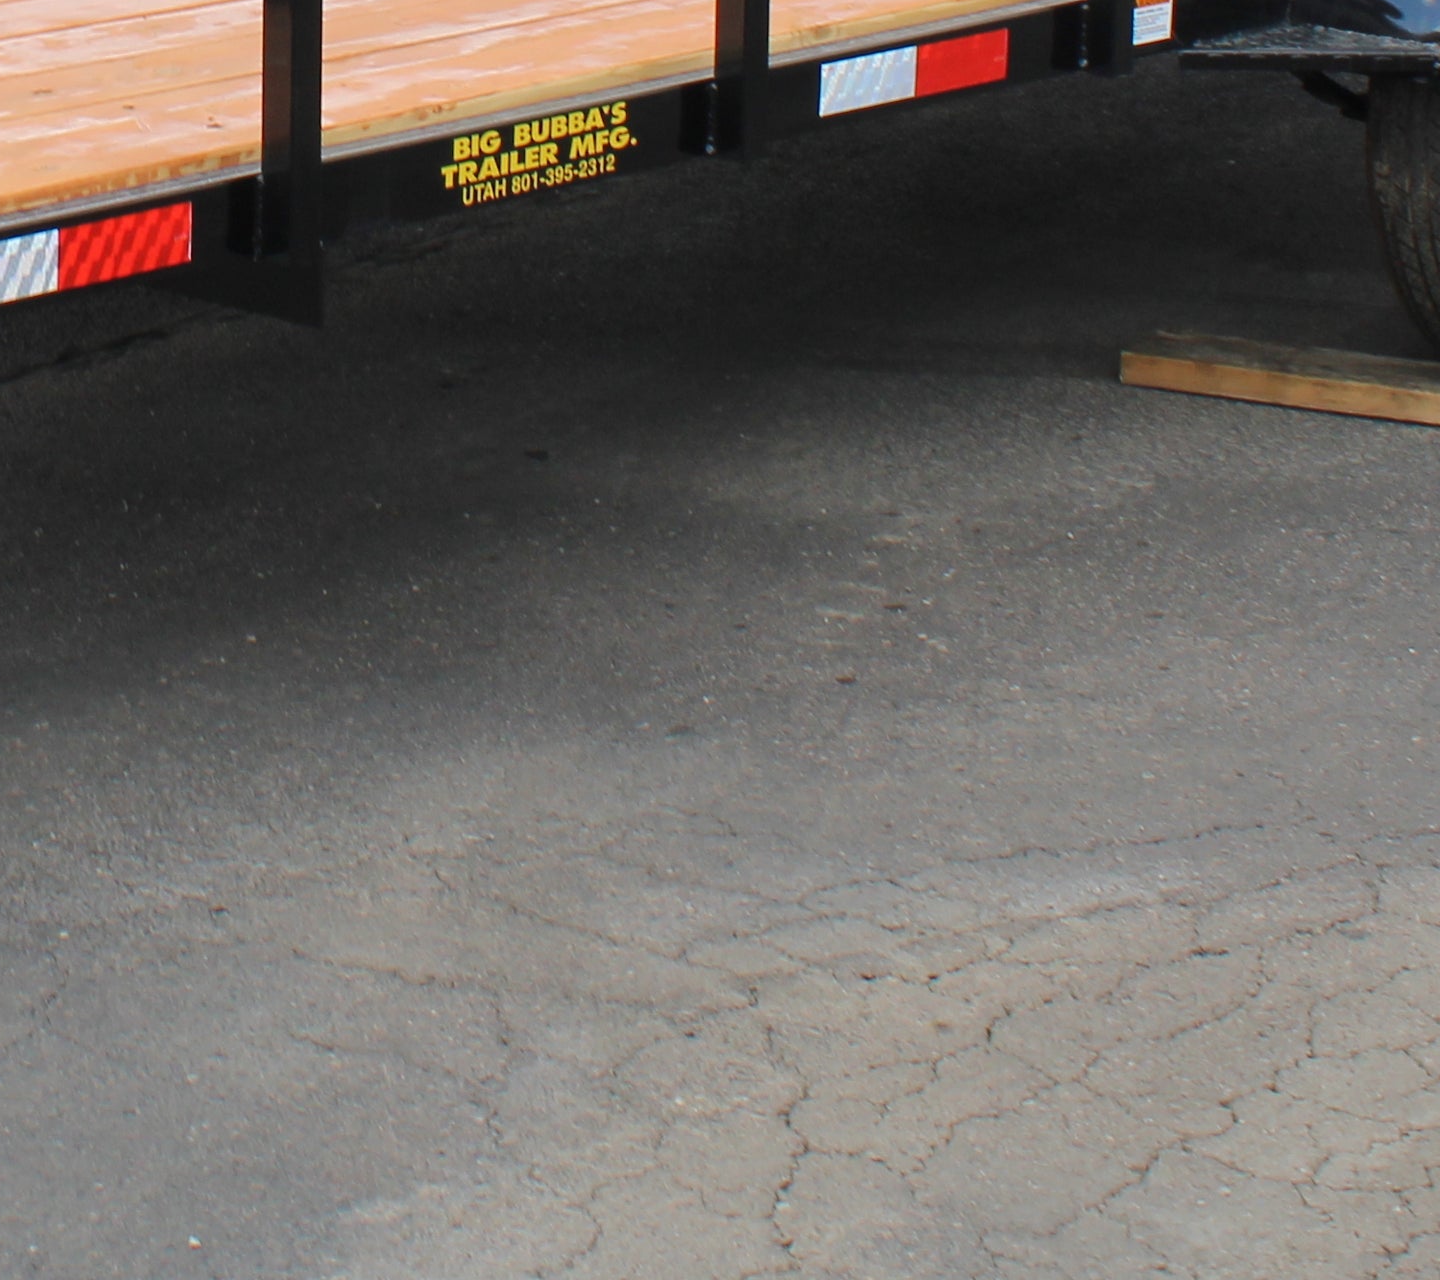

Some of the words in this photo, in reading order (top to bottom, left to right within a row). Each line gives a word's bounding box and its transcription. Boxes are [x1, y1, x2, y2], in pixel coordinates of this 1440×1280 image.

[441, 142, 559, 189] TRAILER
[569, 125, 639, 160] MFG.
[453, 130, 501, 161] BIG
[513, 101, 628, 147] BUBBA'S
[462, 179, 508, 207] UTAH
[511, 153, 617, 195] 801-395-2312
